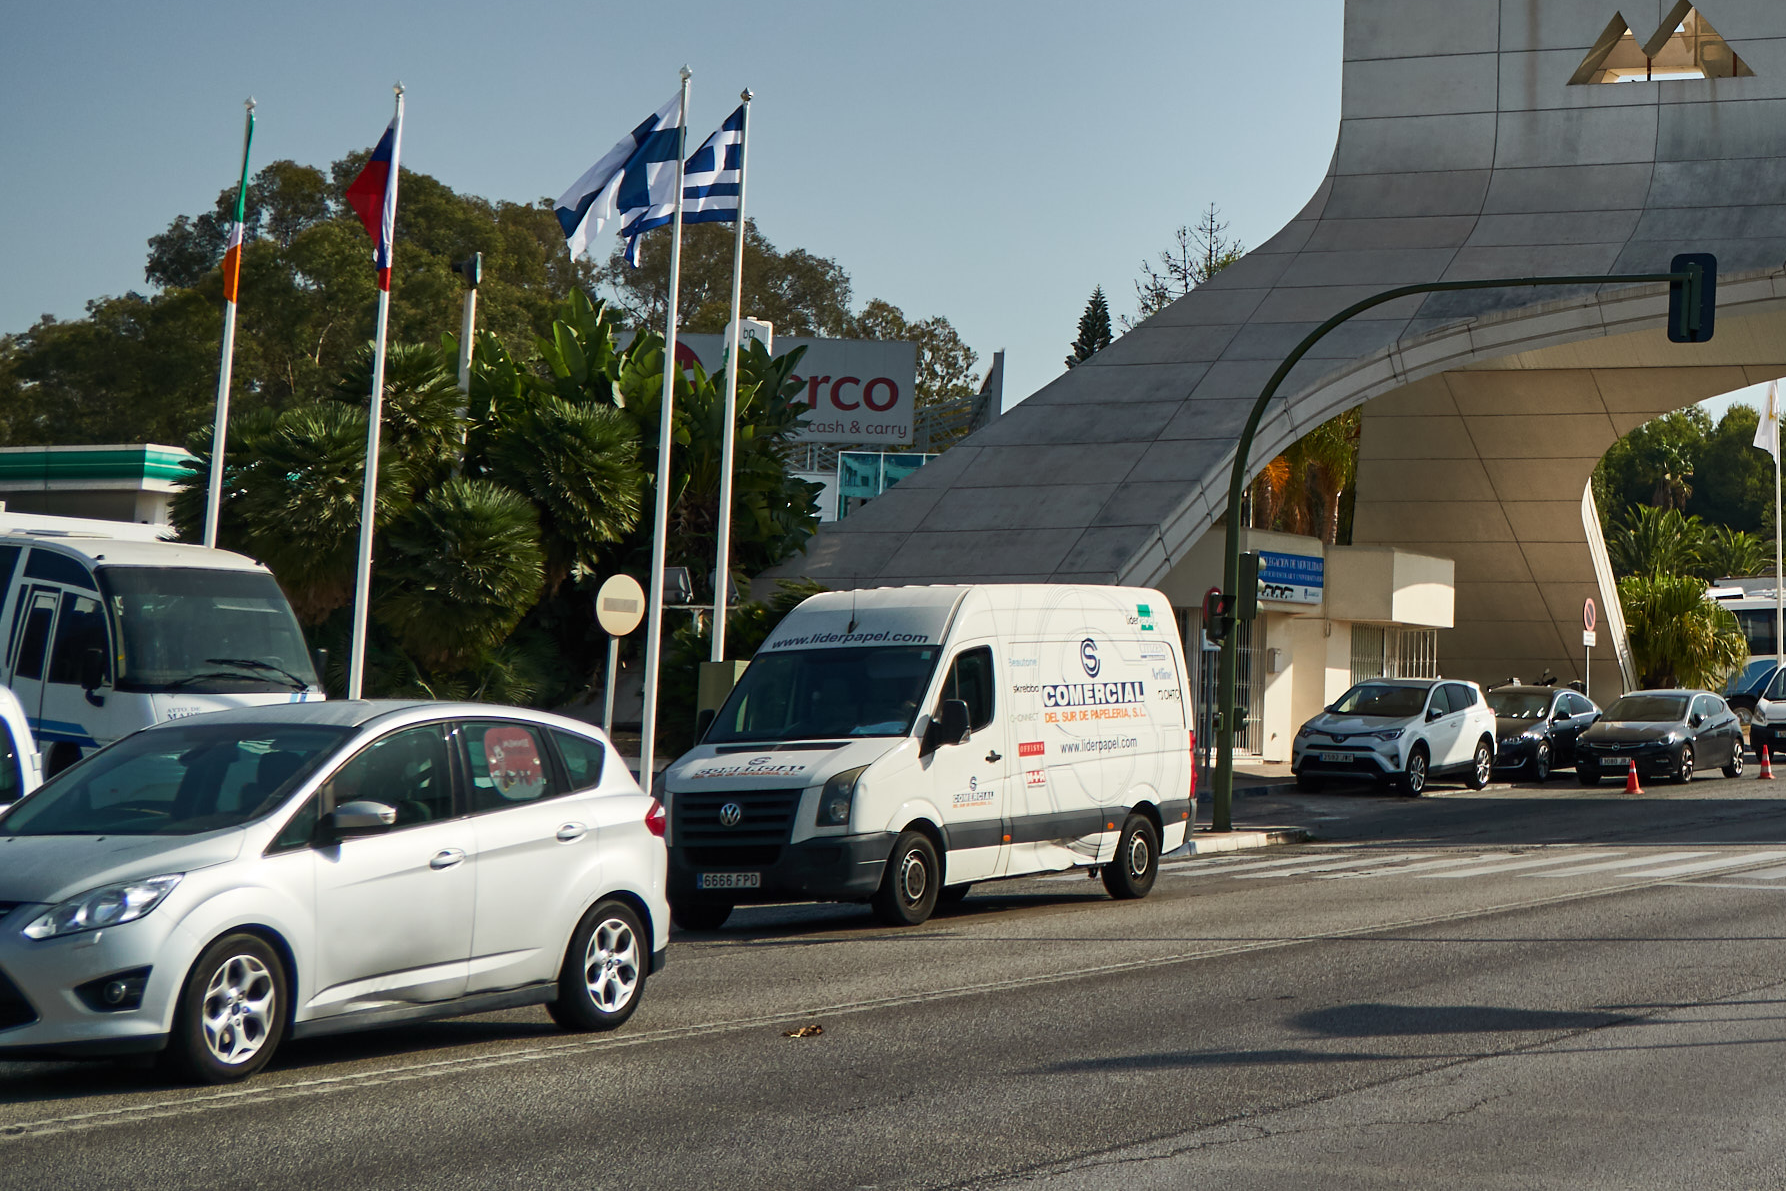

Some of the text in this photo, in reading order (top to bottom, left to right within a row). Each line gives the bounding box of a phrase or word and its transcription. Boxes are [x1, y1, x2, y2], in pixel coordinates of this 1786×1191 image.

[743, 327, 755, 340] bp
[808, 420, 907, 439] cash & carry
[772, 631, 929, 649] www.liderpapel.com
[1042, 681, 1144, 707] COMERCIAL
[1045, 712, 1059, 723] DEL
[1062, 711, 1077, 723] SUR
[1079, 710, 1089, 721] DE
[1060, 737, 1137, 754] www.liderpapel.com
[704, 873, 758, 887] 6666 FPD
